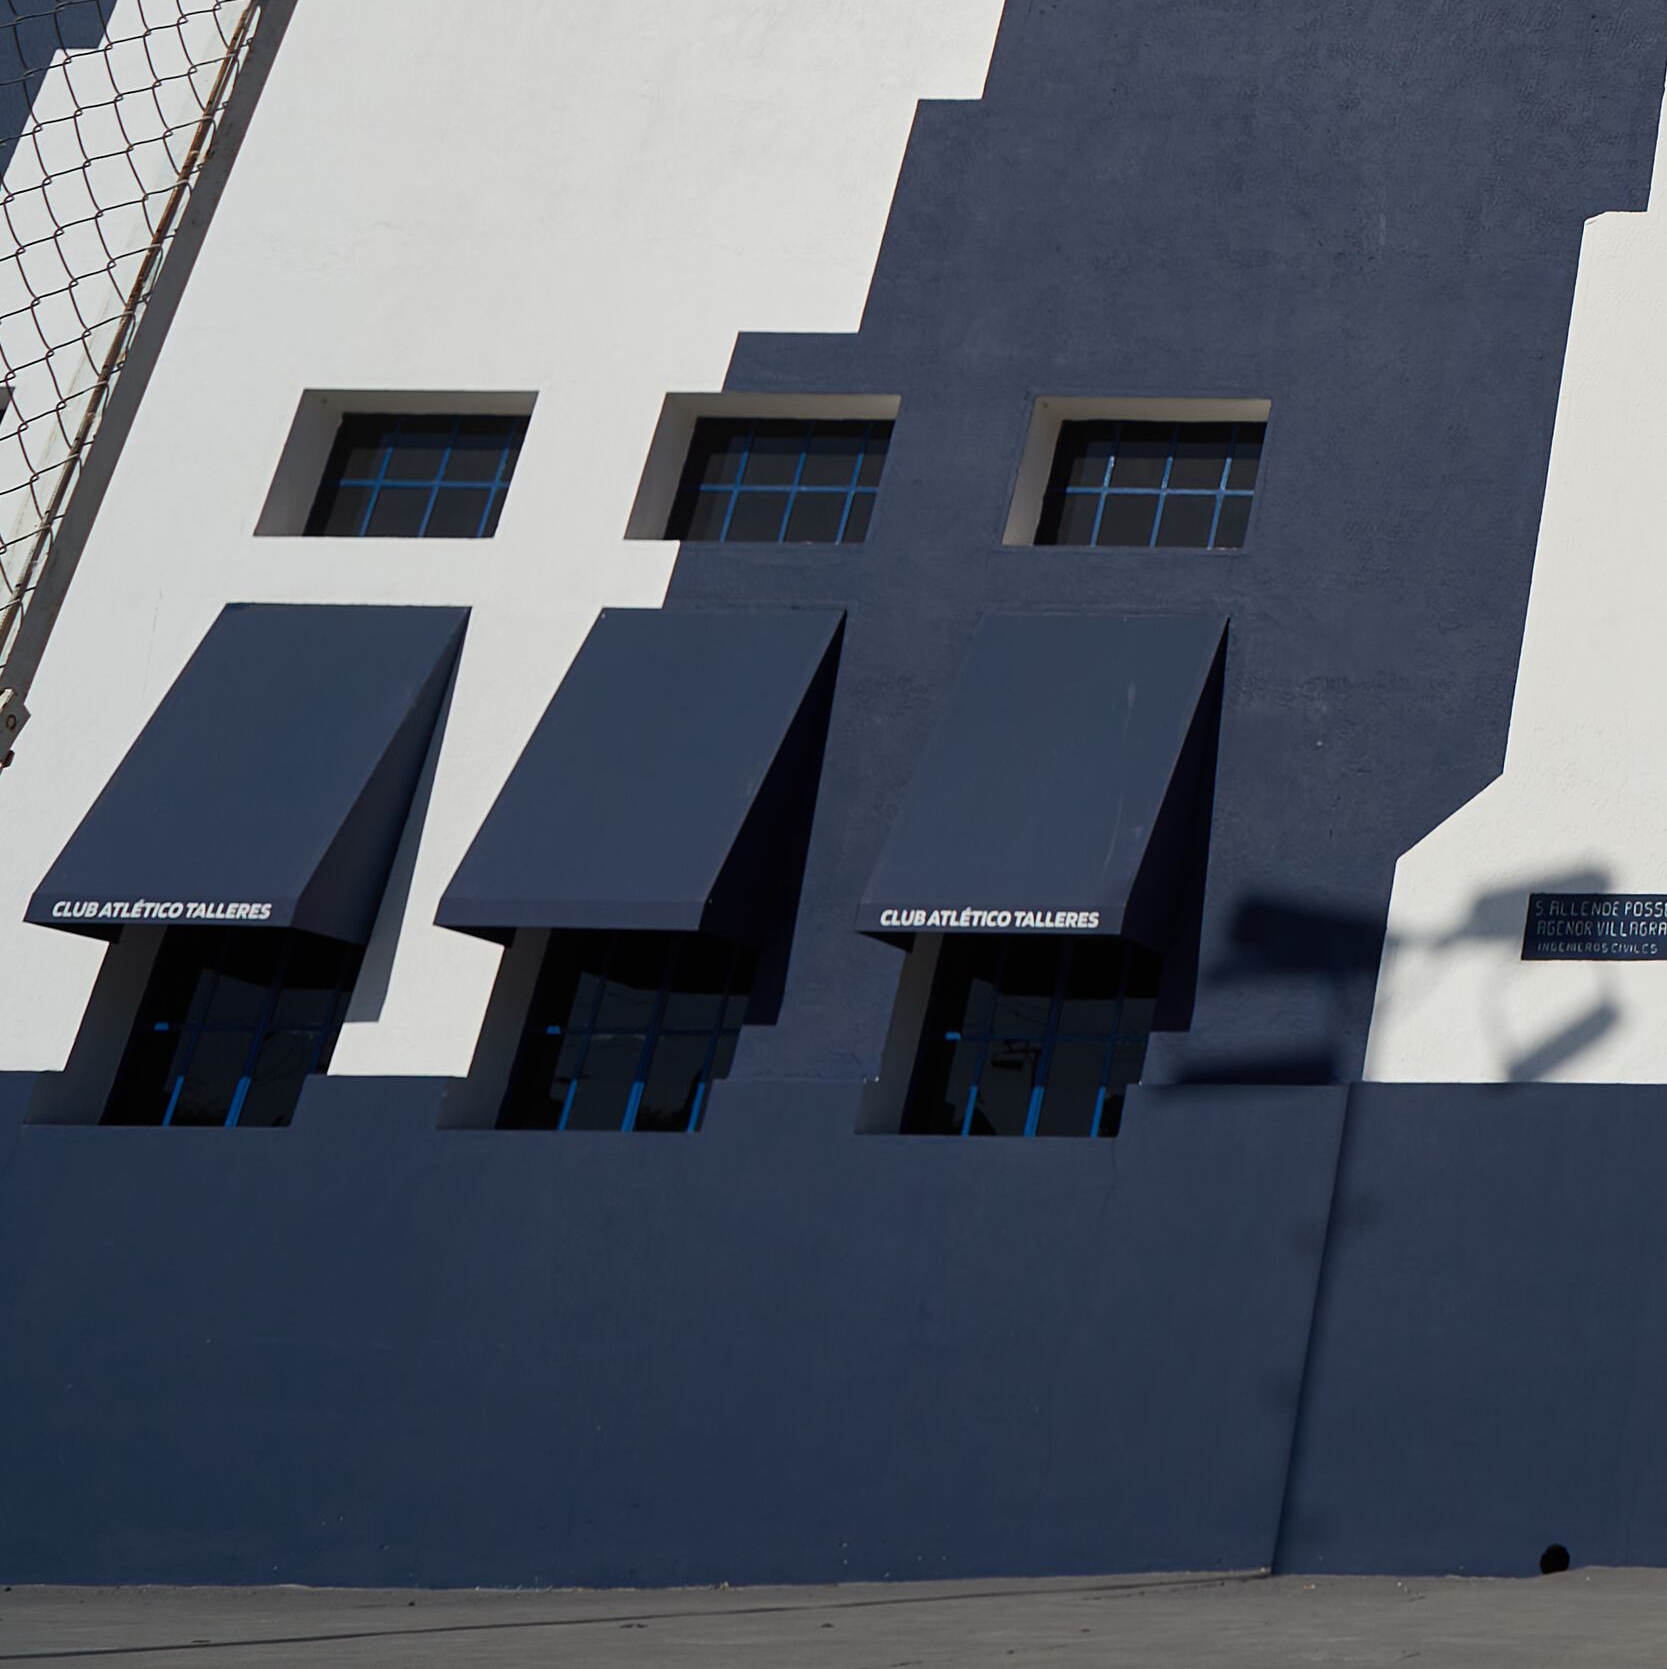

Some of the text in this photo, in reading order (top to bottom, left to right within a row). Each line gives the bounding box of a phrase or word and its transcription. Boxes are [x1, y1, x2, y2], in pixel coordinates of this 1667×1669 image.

[52, 899, 272, 919] CLUB ATLÉTICO TALLERES
[1549, 900, 1620, 917] ALLENDE
[880, 907, 1100, 929] CLUB ATLÉTICO TALLERES
[1536, 920, 1667, 938] AGENOR VILLAGRA
[1537, 942, 1658, 955] INGENIEROS CIVILES
